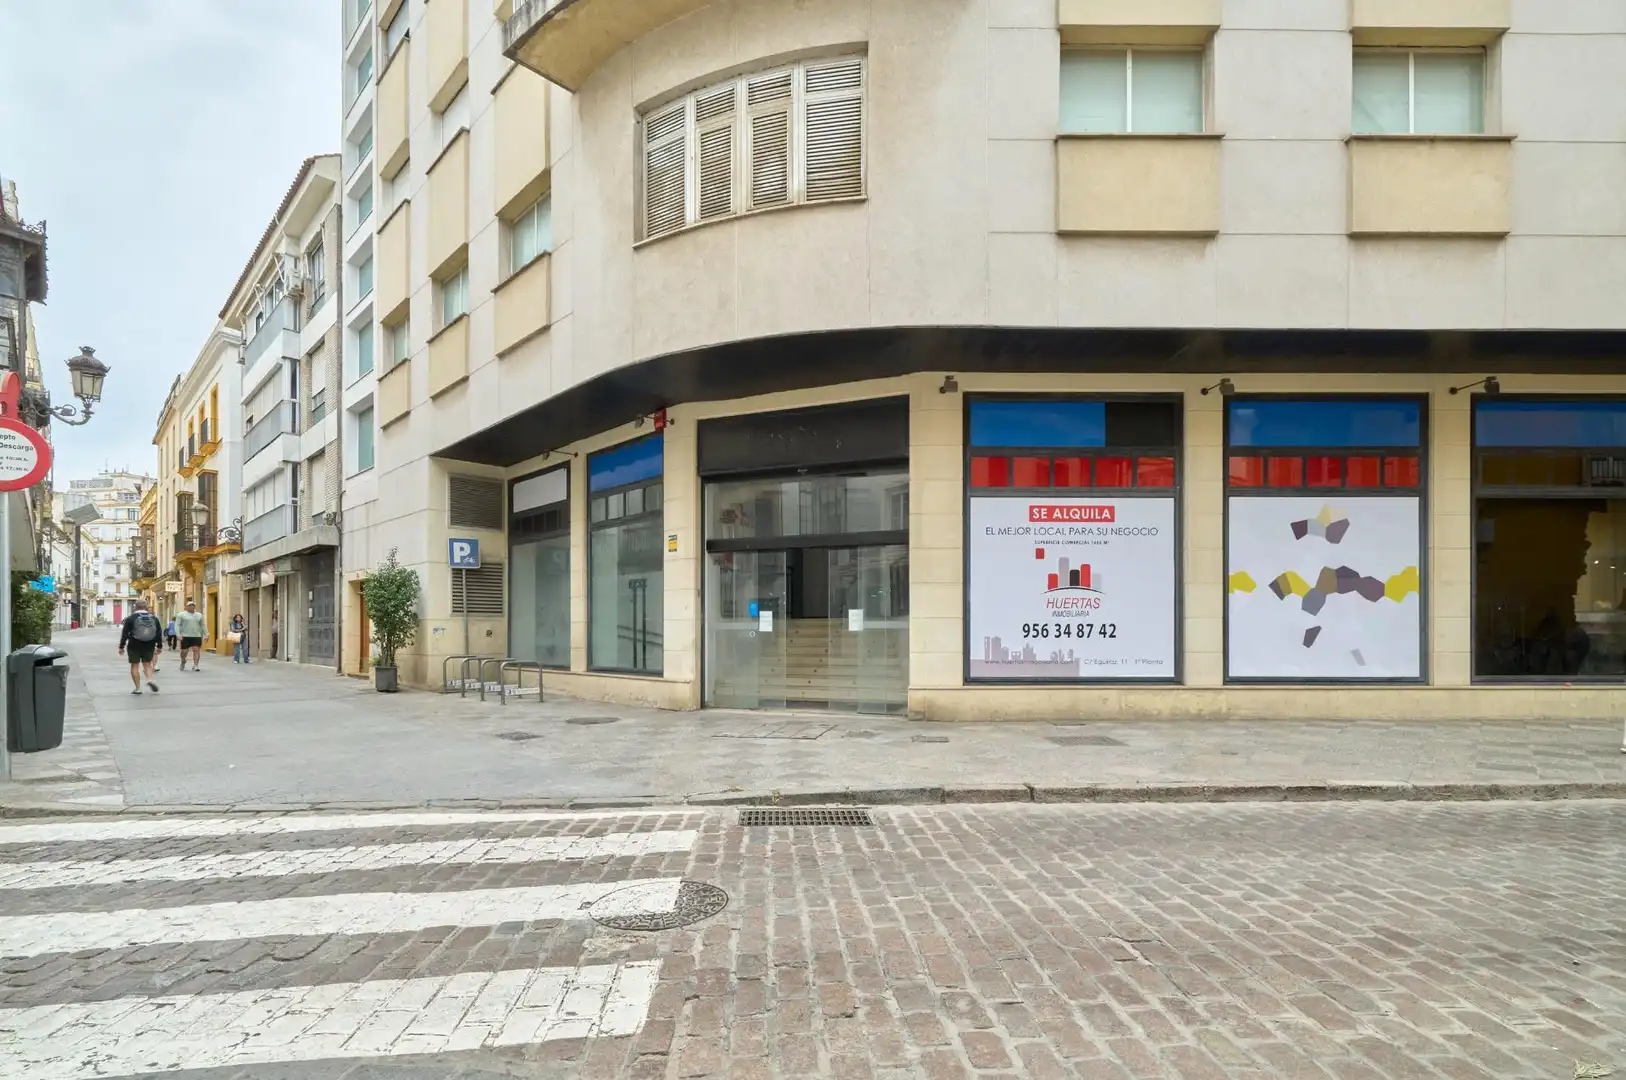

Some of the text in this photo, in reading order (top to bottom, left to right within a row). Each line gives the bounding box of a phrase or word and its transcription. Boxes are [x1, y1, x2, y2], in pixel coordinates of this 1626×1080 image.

[1032, 508, 1112, 520] SE ALQUILA
[985, 527, 1159, 537] EL MEJOR LOCAL PARA SU NEGOCIO
[453, 542, 471, 564] P
[1046, 597, 1101, 609] HUERTAS
[1052, 610, 1090, 618] INMOBILIARIA
[1022, 623, 1117, 639] 956 34 87 42
